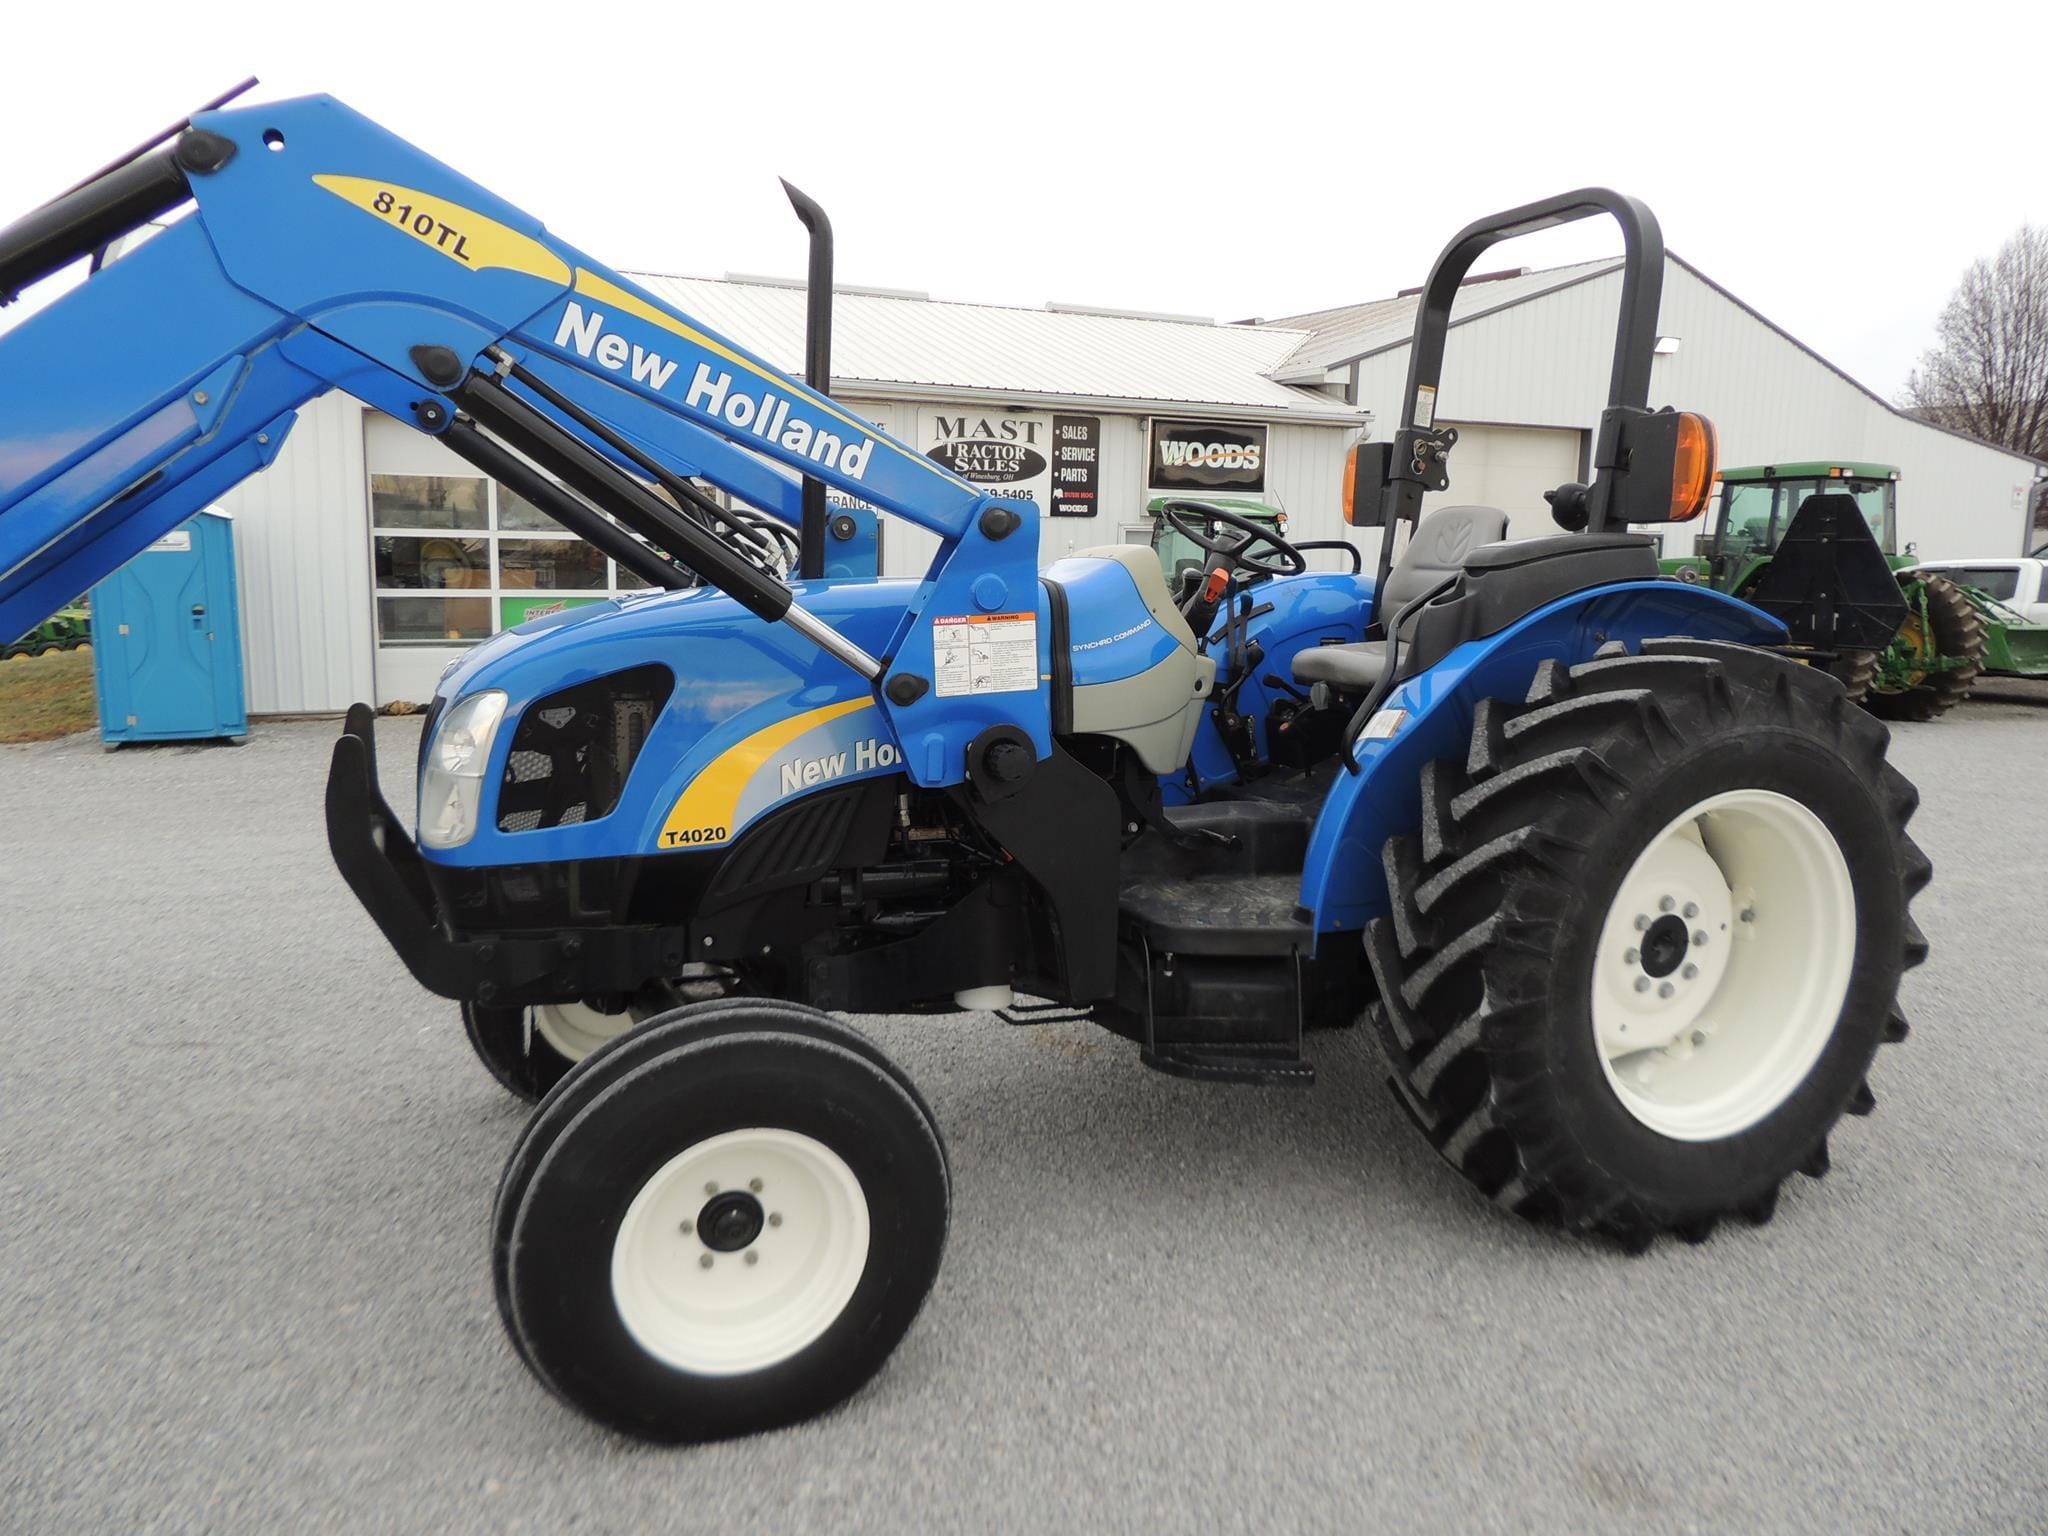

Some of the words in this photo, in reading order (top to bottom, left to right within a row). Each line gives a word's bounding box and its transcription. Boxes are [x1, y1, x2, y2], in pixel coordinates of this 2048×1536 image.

[372, 191, 470, 261] 810TL
[554, 301, 678, 391] New
[685, 362, 875, 480] Holland
[934, 416, 1043, 445] MAST
[1062, 425, 1088, 440] SALES
[943, 441, 1027, 461] TRACTOR
[1061, 446, 1096, 462] SERVICE
[1160, 440, 1260, 470] WOODS
[954, 457, 1020, 473] SALES
[1002, 473, 1014, 481] OH
[1060, 467, 1088, 483] PARTS
[983, 488, 1034, 500] 9-5405
[1058, 504, 1088, 513] WOODS
[1072, 637, 1113, 652] SYNCHRO
[1113, 618, 1152, 641] COMMAND
[780, 752, 847, 795] New
[855, 738, 902, 771] Ho
[666, 827, 726, 845] T4020
